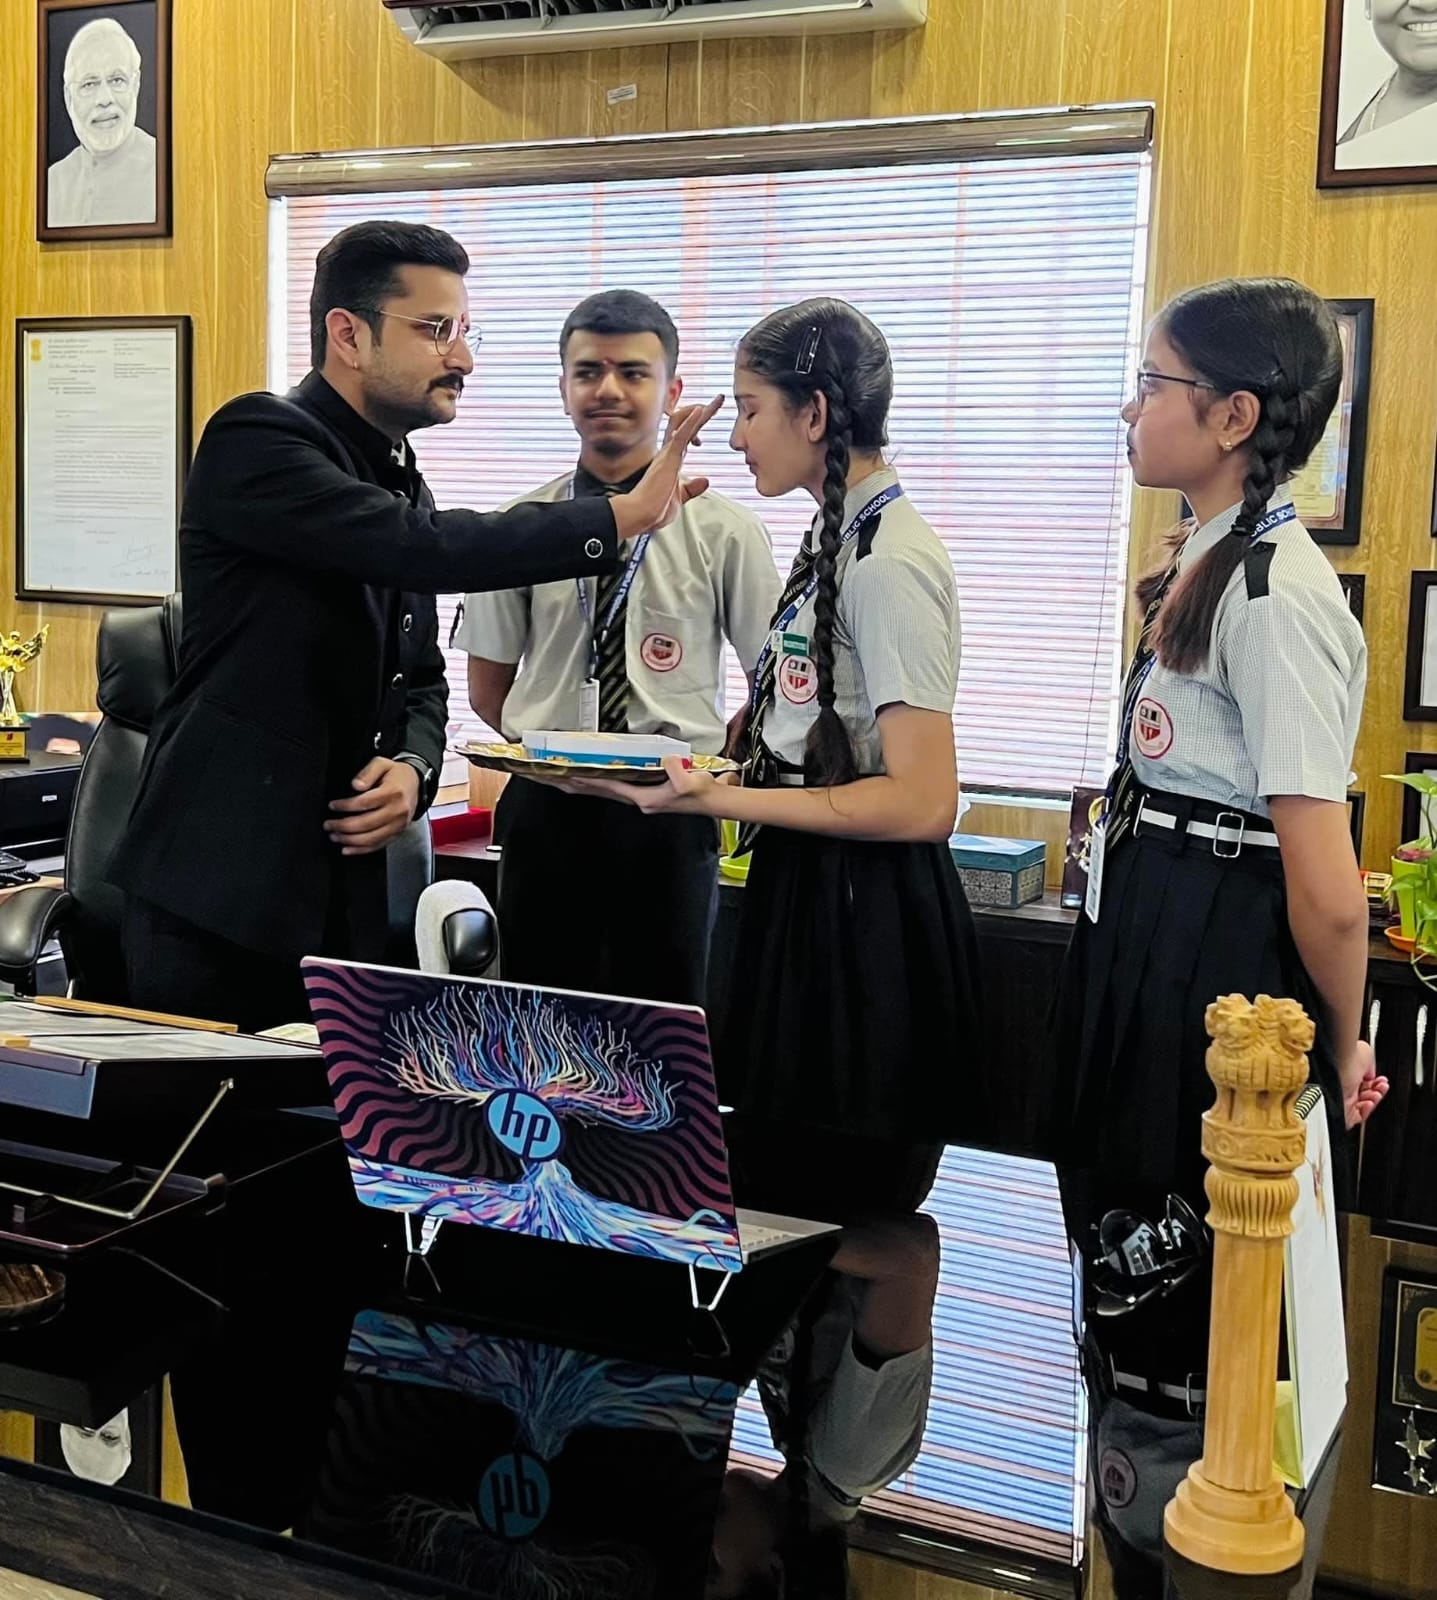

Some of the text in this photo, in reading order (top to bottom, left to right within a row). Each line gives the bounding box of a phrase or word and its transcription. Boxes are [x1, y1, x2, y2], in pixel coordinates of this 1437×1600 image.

[841, 493, 892, 545] UBLIC SCHOOL
[499, 1090, 552, 1159] hp
